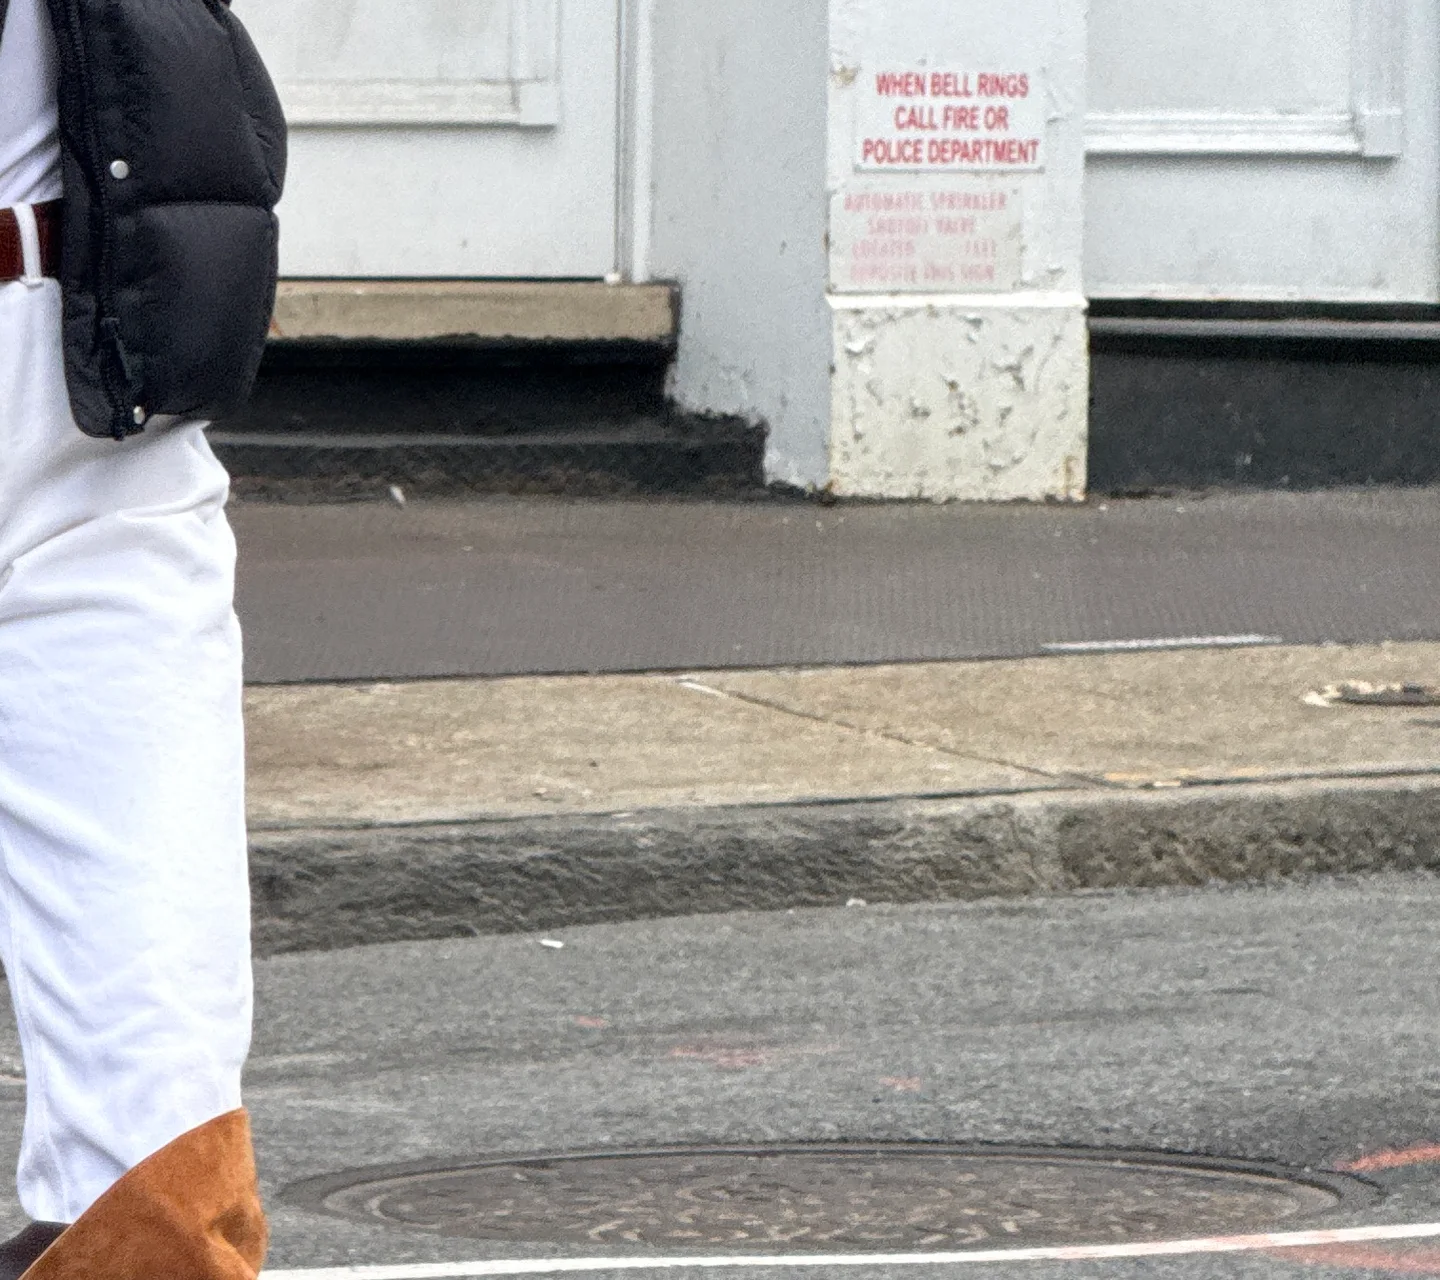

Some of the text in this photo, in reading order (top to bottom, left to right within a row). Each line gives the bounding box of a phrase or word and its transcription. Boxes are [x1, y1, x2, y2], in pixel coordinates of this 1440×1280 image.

[876, 72, 1029, 98] WHEN BELL RINGS
[894, 104, 1009, 131] CALL FIRE OR
[862, 138, 1040, 164] POLICE DEPARTMENT
